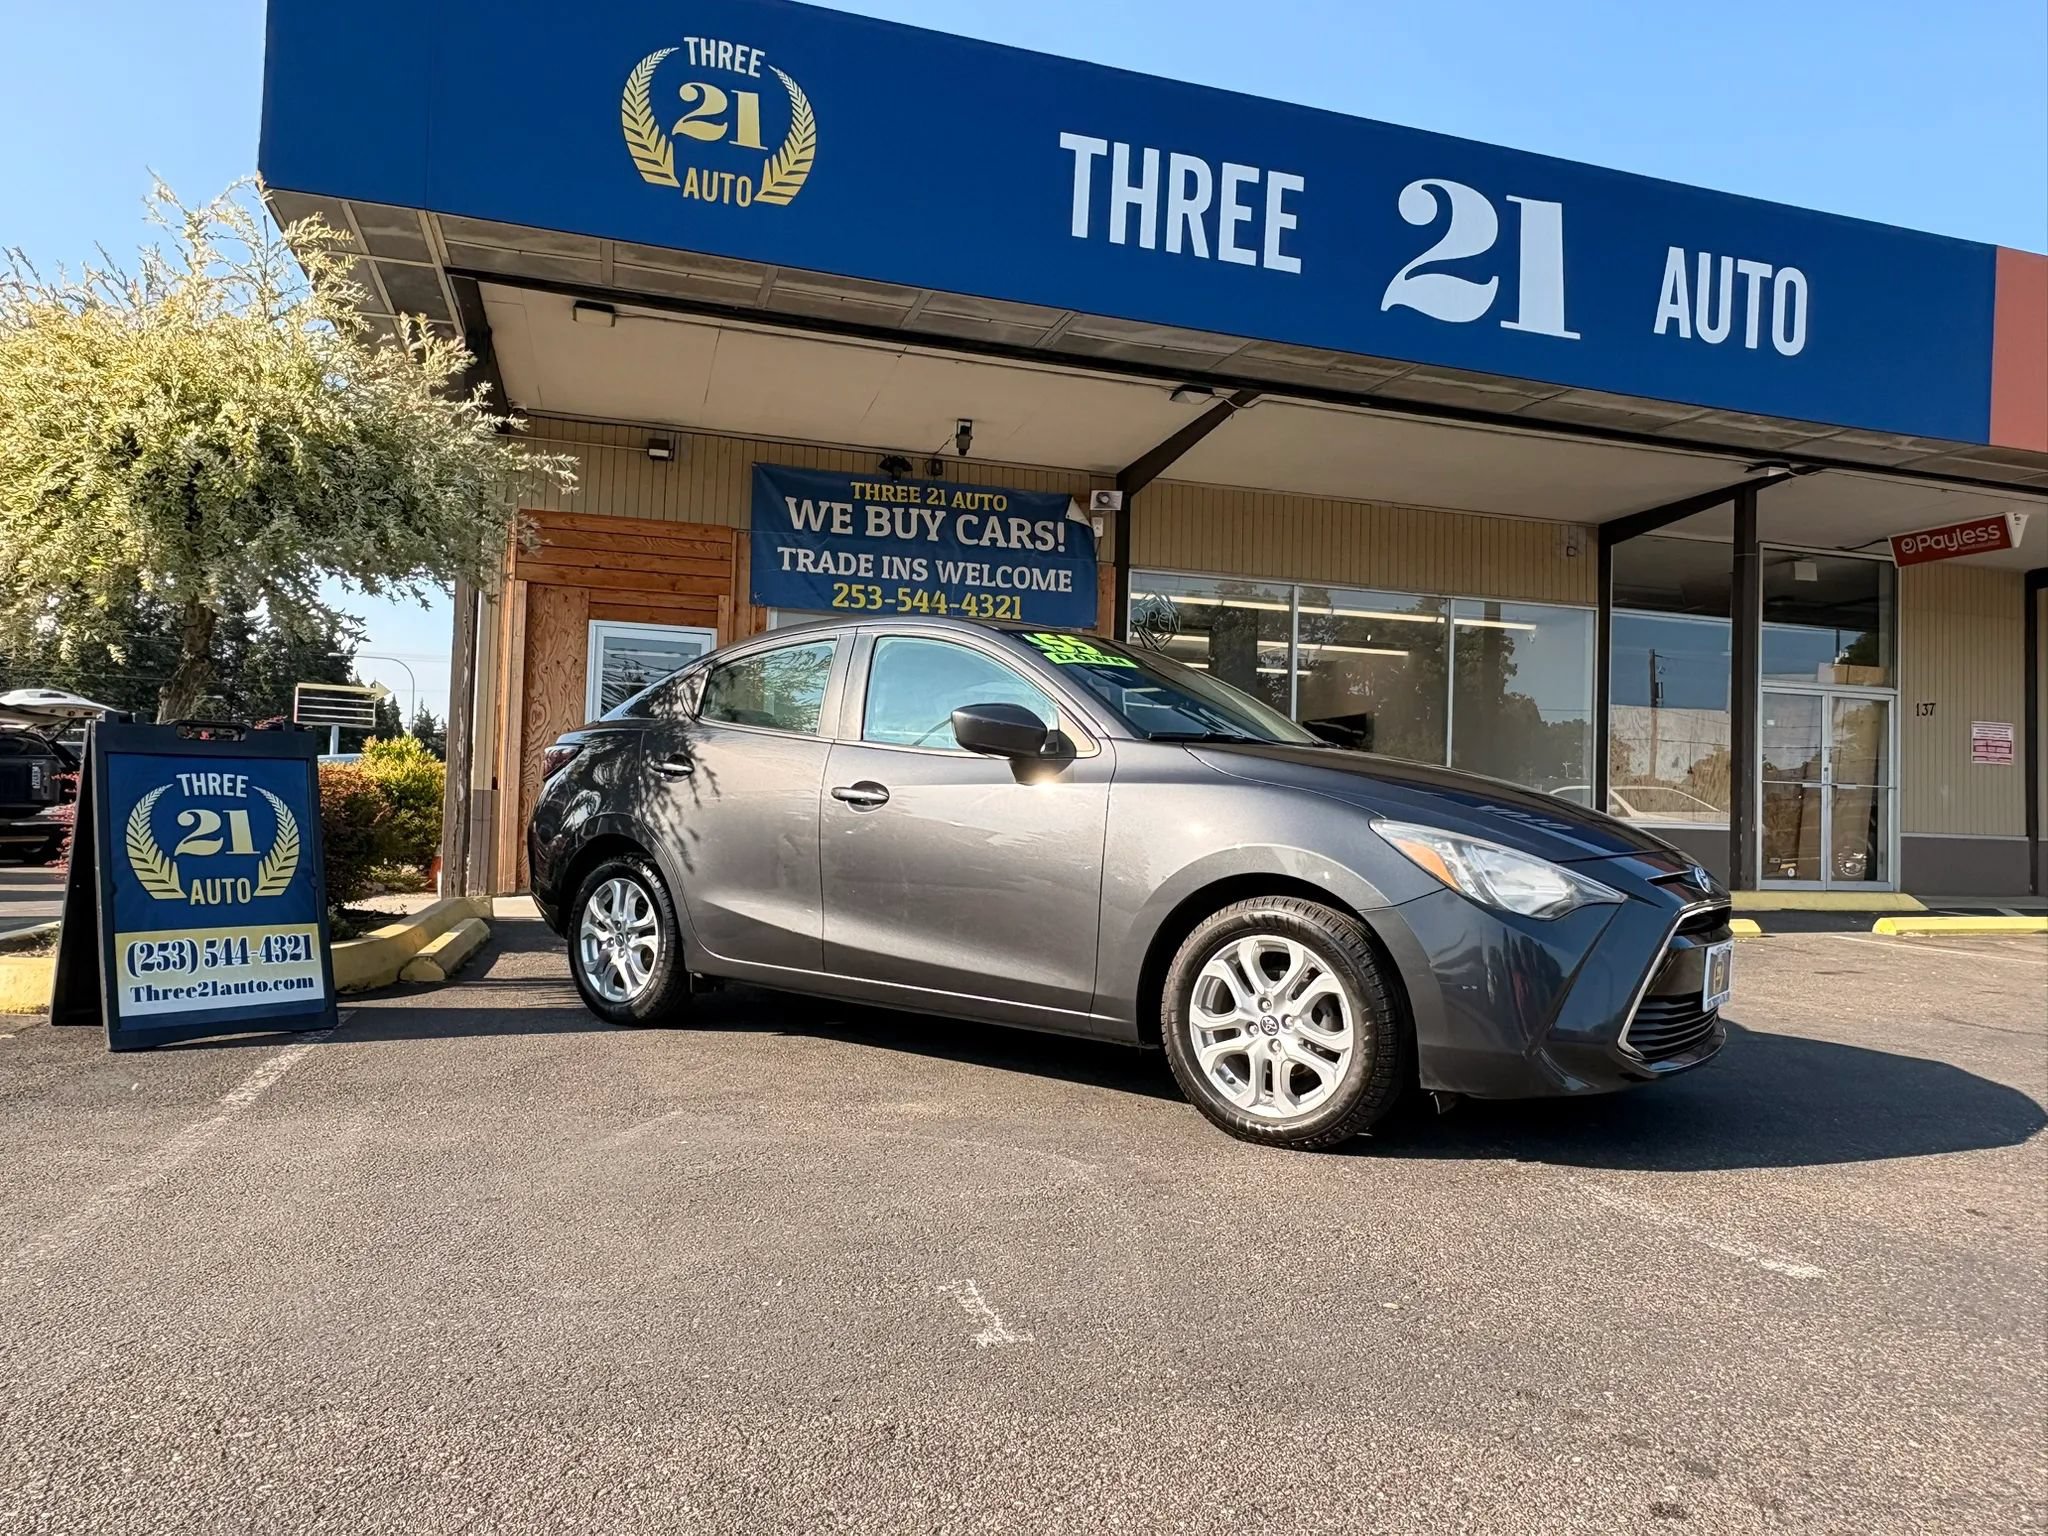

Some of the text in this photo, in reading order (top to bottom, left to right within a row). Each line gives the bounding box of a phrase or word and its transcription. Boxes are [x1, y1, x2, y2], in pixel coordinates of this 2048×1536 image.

[683, 36, 766, 78] THREE
[671, 82, 768, 151] 21
[682, 169, 752, 208] AUTO
[1058, 131, 1808, 357] THREE 21 AUTO
[850, 481, 1008, 512] THREE 21 AUTO
[785, 496, 1067, 553] WE BUY CARS!
[1916, 524, 2001, 552] Payless
[777, 547, 1073, 593] TRADE INS WELCOME
[832, 582, 1022, 620] 253-544-4321
[1916, 702, 1937, 716] 137
[176, 773, 249, 798] THREE
[174, 809, 261, 857] 21
[190, 877, 251, 905] AUTO
[126, 934, 314, 977] (253) 544-4321
[130, 976, 315, 1003] Three21auto.com
